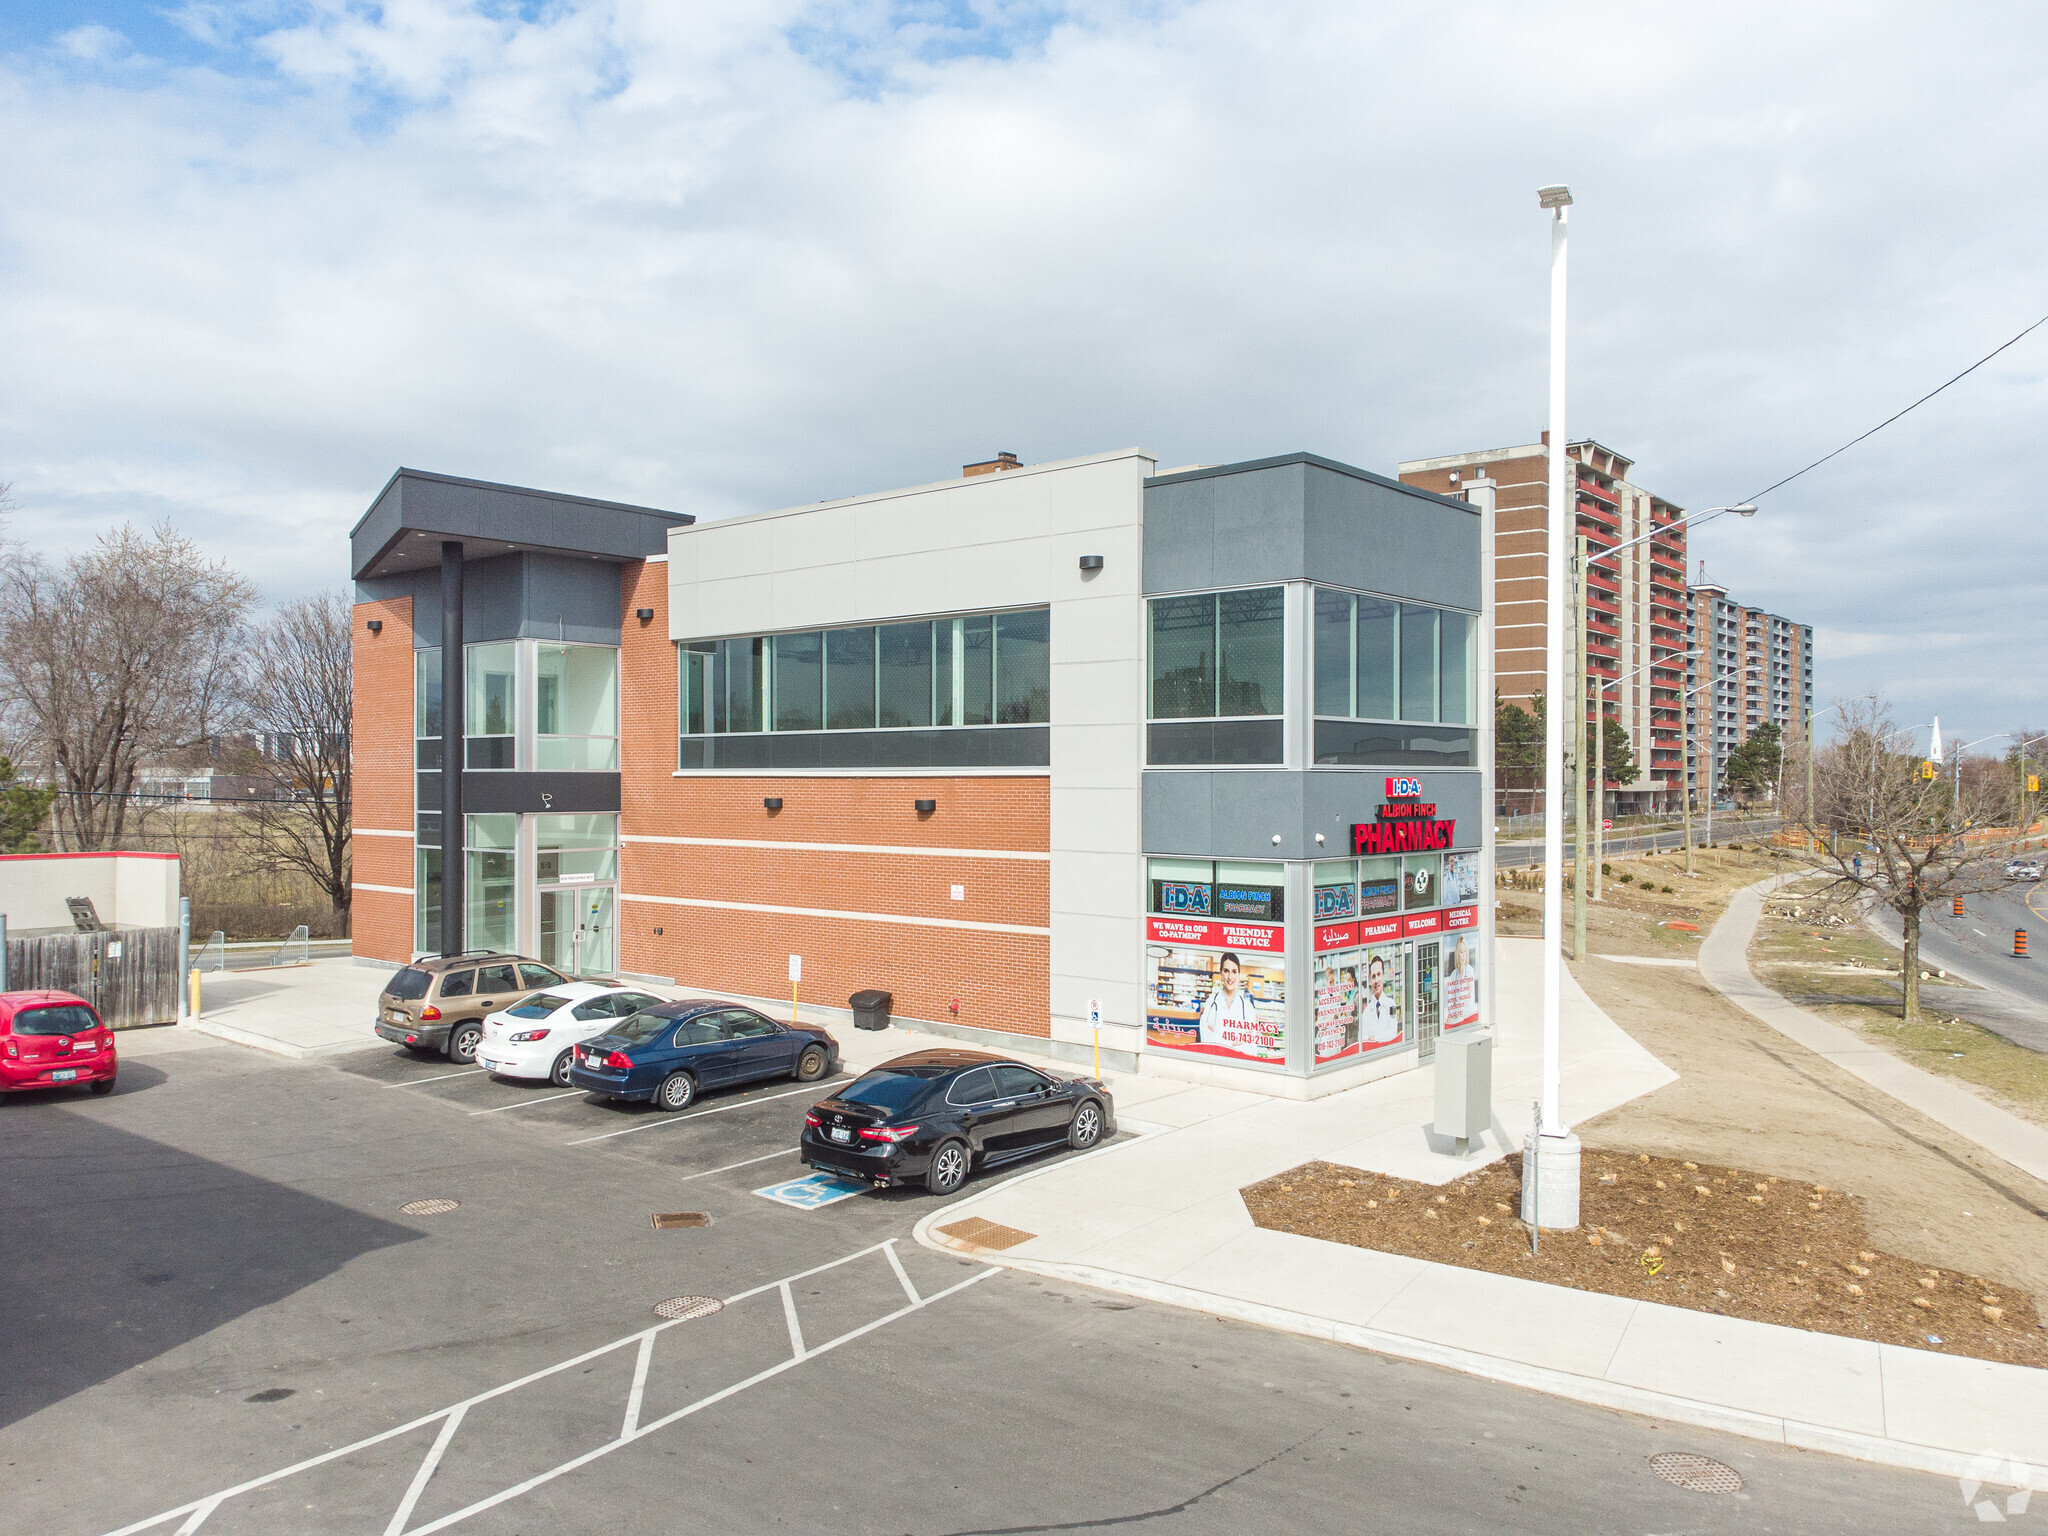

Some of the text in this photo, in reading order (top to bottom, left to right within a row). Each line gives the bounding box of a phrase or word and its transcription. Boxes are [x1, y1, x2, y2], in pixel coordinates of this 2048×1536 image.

[1382, 803, 1437, 818] ALBION FINCH
[1355, 819, 1456, 855] PHARMACY
[1219, 889, 1271, 902] ALBION FINCH
[1224, 902, 1266, 914] PHARMACY
[1449, 909, 1472, 919] MEDICAL
[1152, 922, 1208, 933] WE WAVE $2 ODB
[1408, 917, 1437, 930] WELCOME
[1449, 917, 1470, 927] CENTRE
[1159, 930, 1202, 940] CO-PAYMENT
[1223, 926, 1274, 938] FRIENDLY
[1364, 923, 1398, 937] PHARMACY
[1226, 935, 1270, 947] SERVICE
[1322, 928, 1349, 946] صيدلية
[1318, 996, 1341, 1006] ACCEPTED
[1223, 1018, 1280, 1034] PHARMACY
[1222, 1030, 1275, 1047] 416-743-2100
